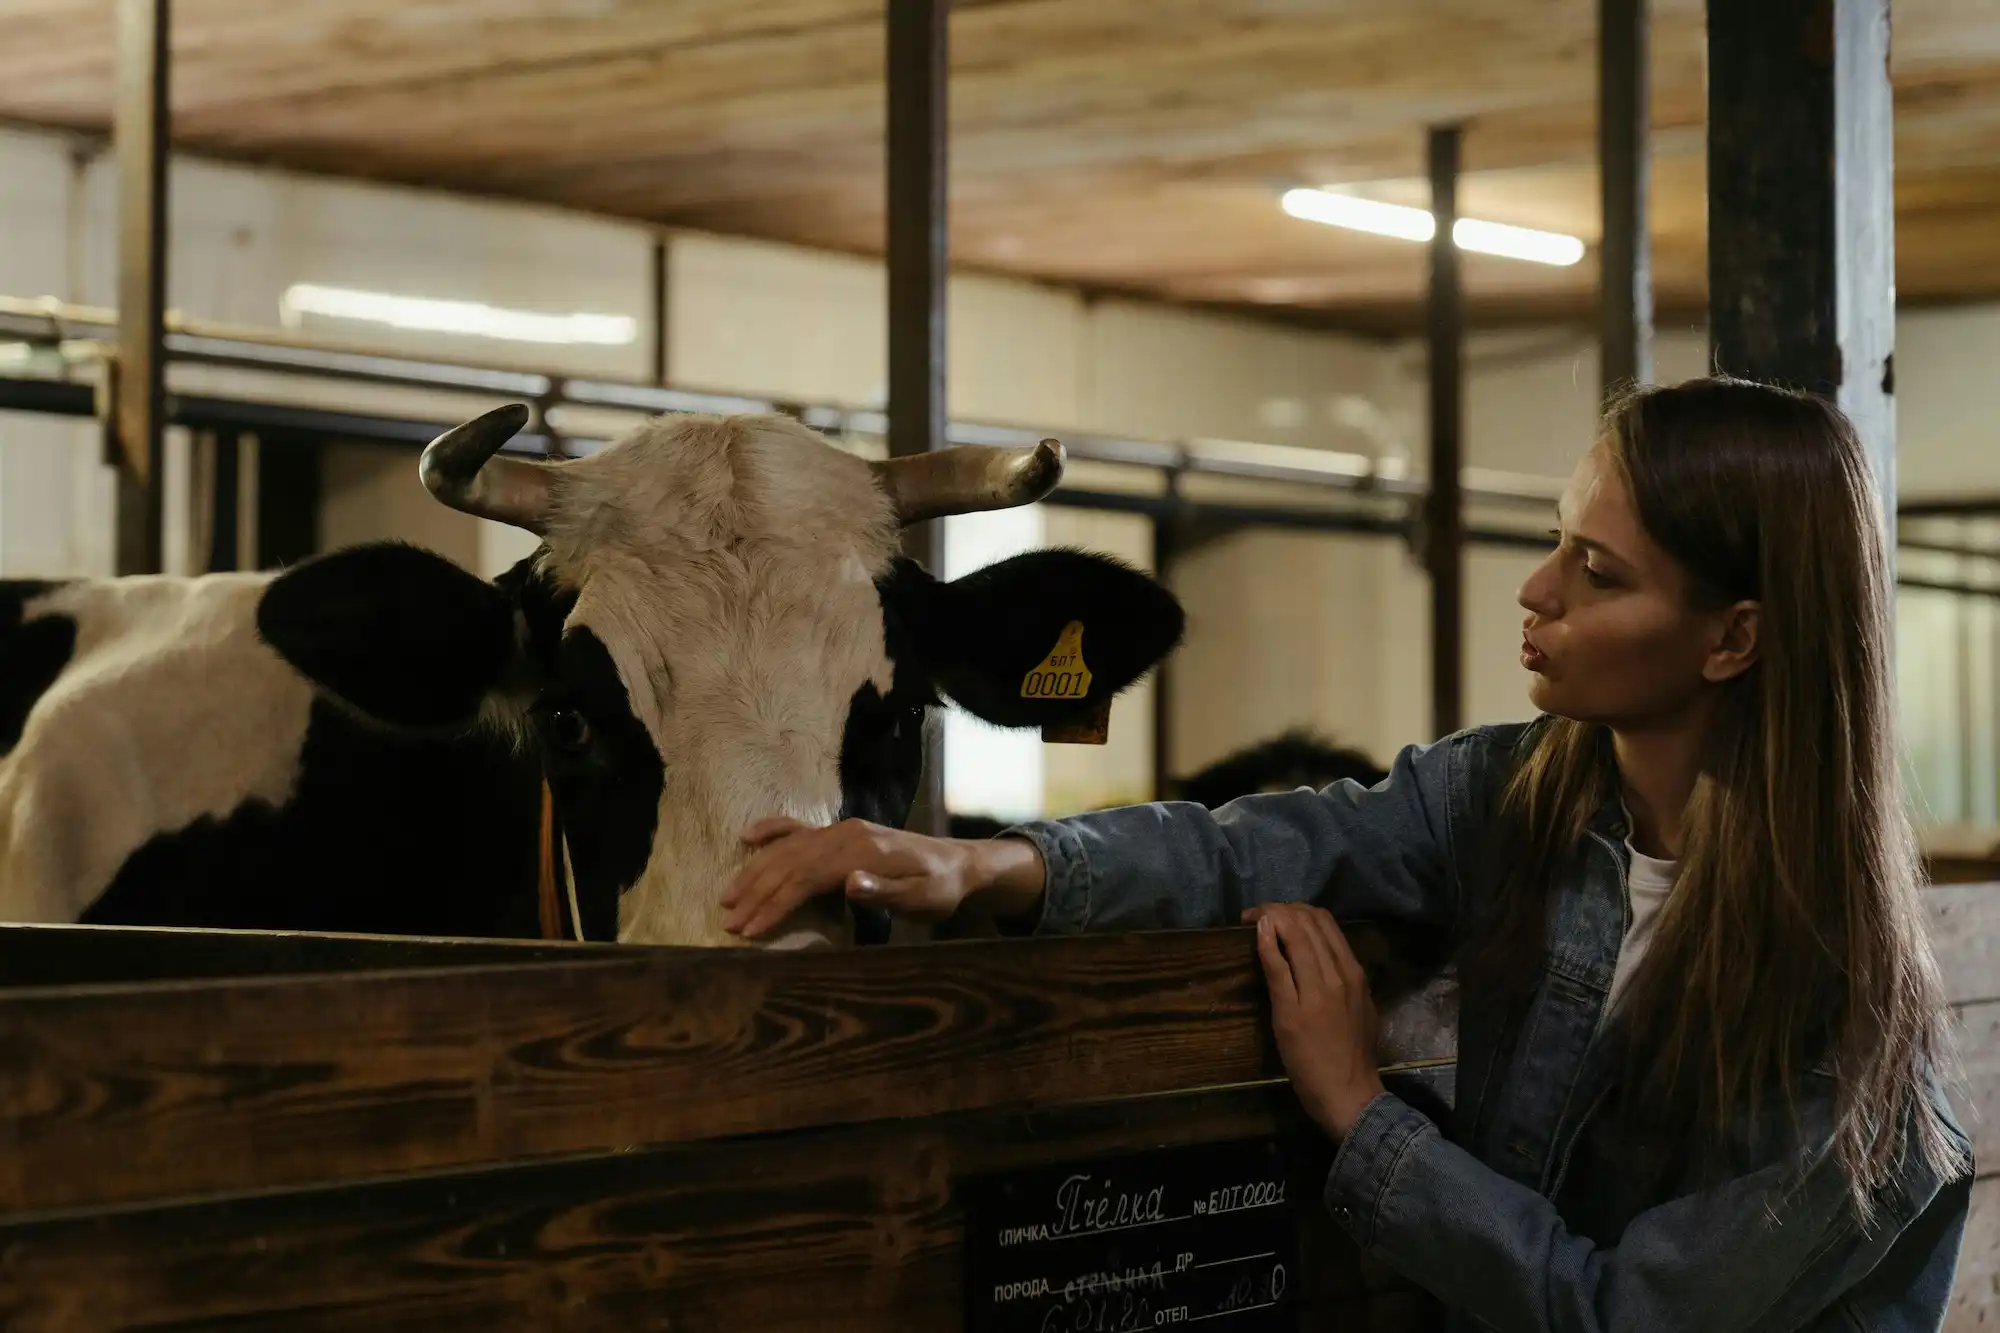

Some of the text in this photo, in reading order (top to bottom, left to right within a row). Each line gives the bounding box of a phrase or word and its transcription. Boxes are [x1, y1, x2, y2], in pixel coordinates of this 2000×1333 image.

[1050, 655, 1076, 667] БПТ
[1026, 672, 1083, 696] 0001
[1053, 1174, 1165, 1235] Пчёлка
[995, 1277, 1049, 1302] ПОРОДА
[1175, 1252, 1193, 1273] ДР
[1155, 1306, 1188, 1326] ОТЕЛ
